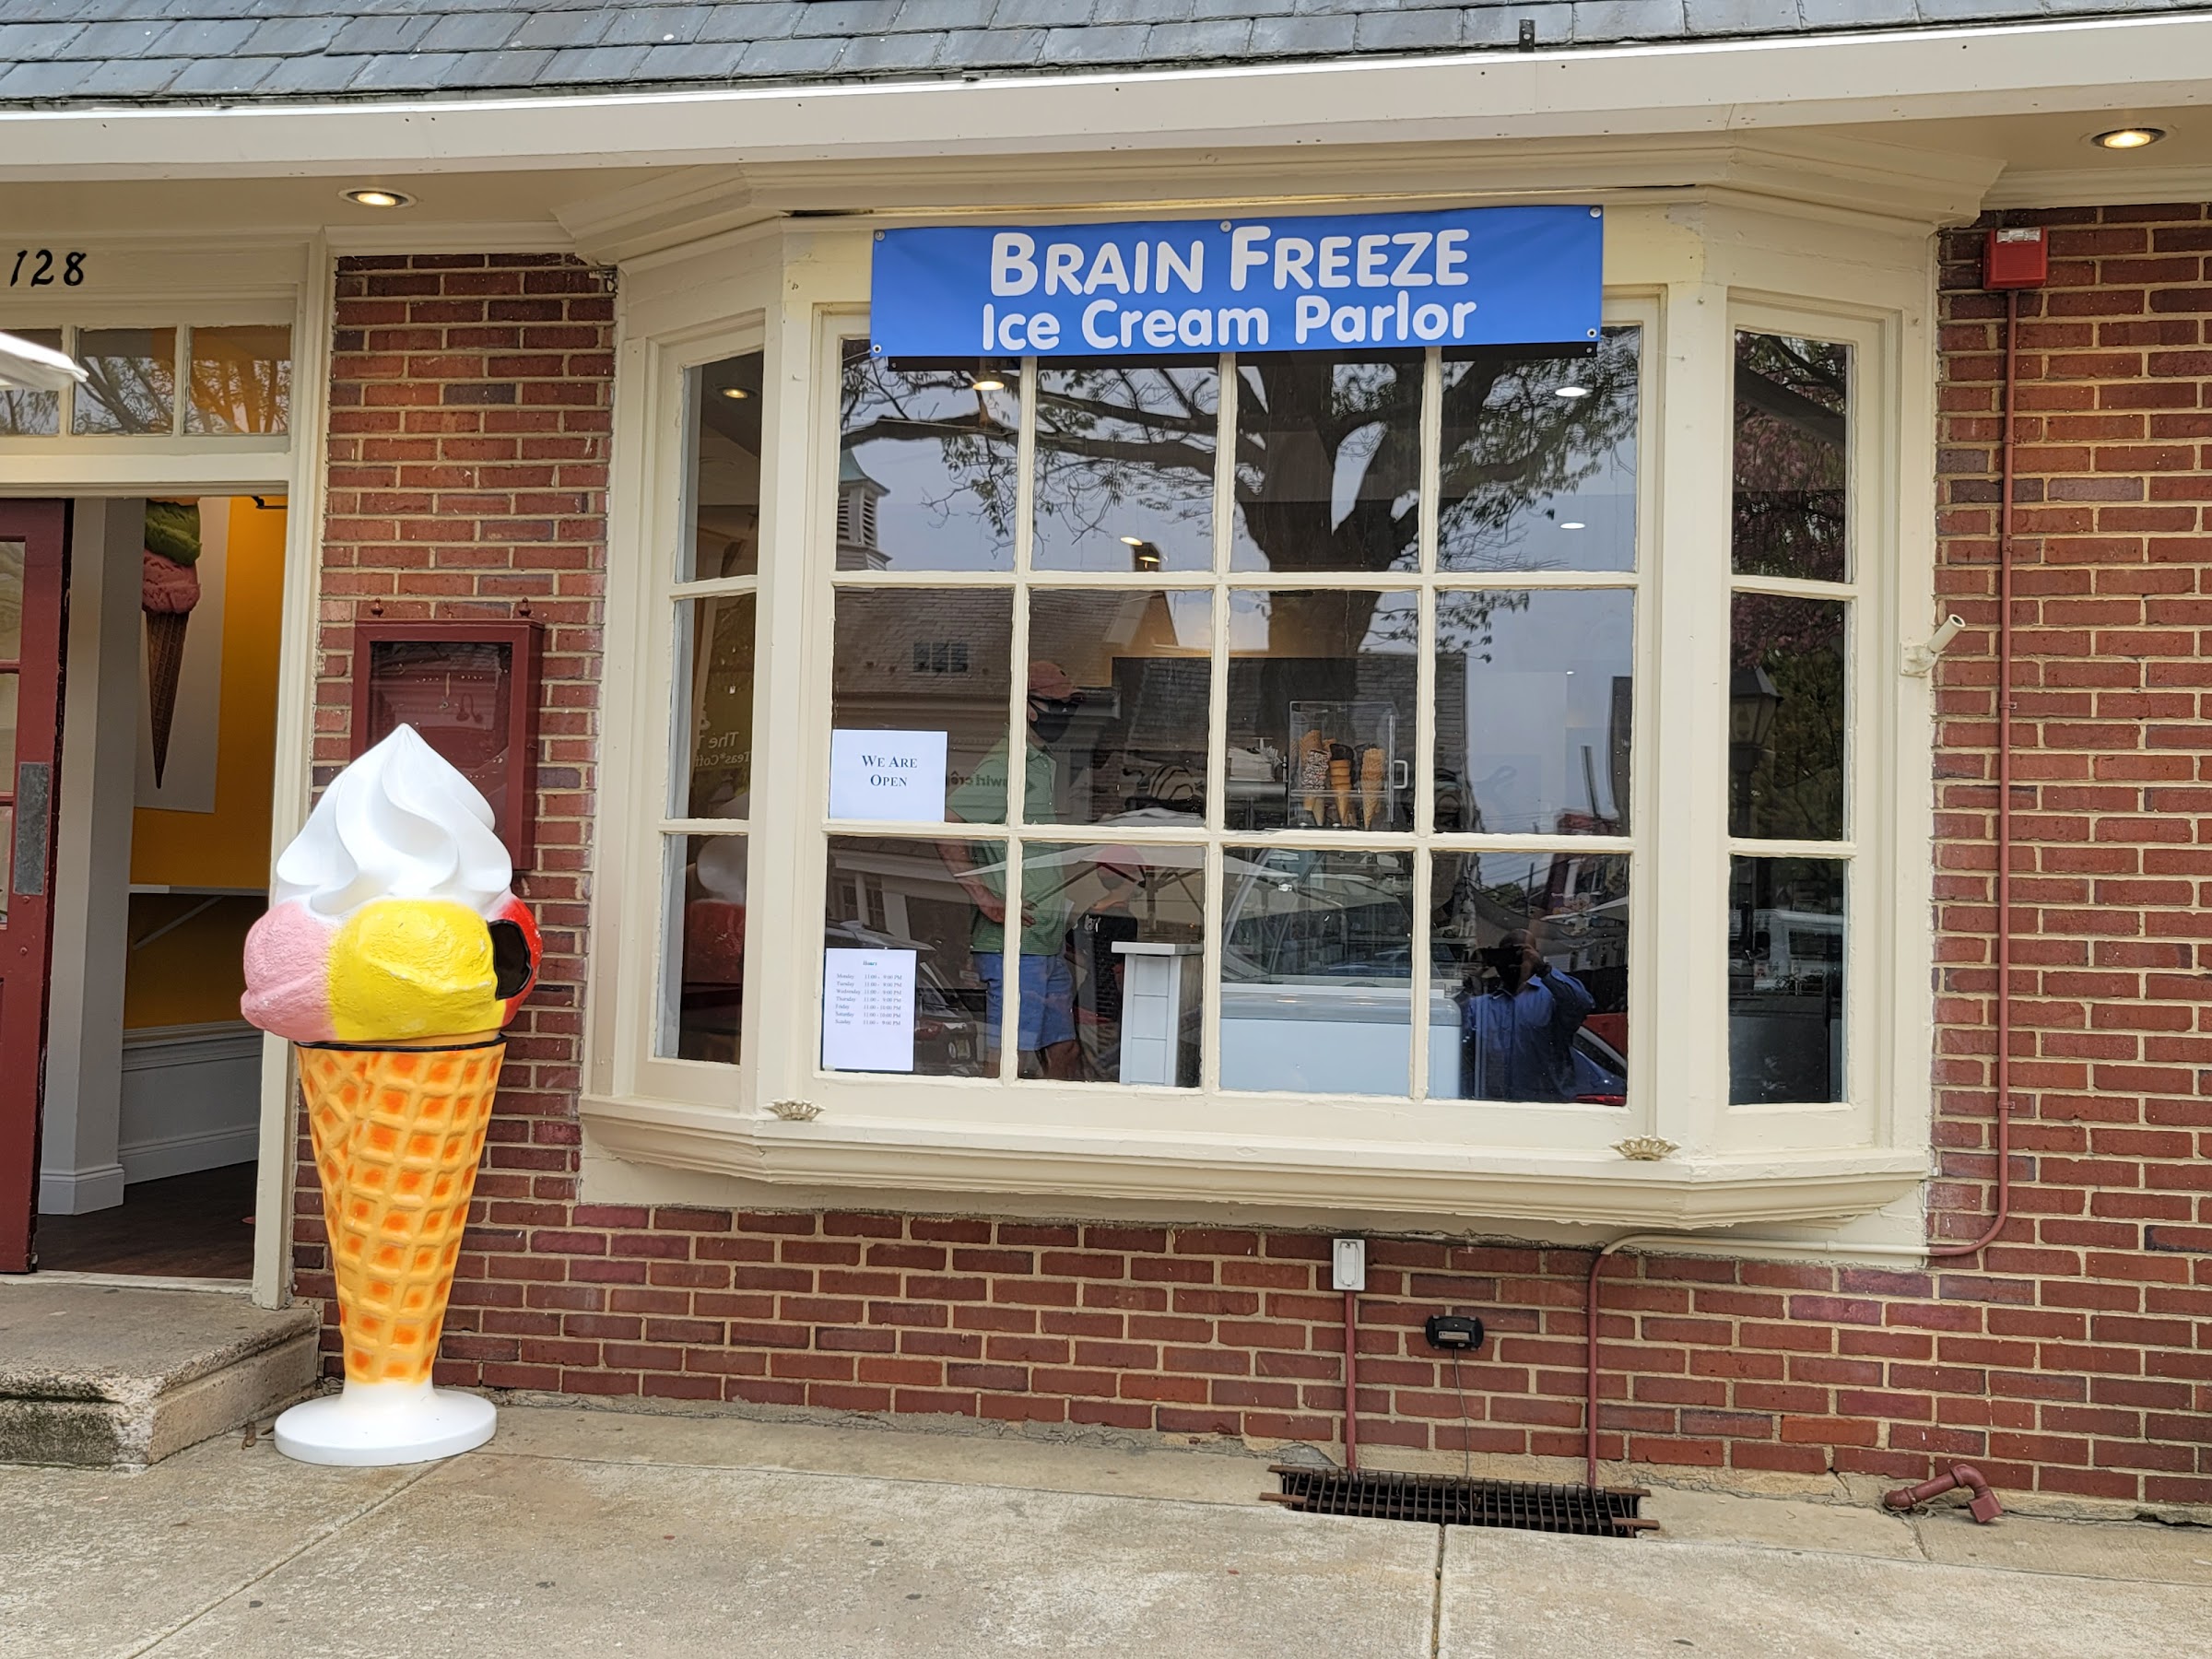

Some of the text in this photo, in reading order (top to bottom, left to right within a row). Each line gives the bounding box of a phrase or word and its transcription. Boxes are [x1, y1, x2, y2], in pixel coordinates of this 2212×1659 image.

[10, 249, 87, 287] 128
[991, 226, 1470, 297] BRAIN FREEZE
[982, 289, 1477, 350] Ice Cream Parlor
[862, 755, 918, 769] WE ARE
[870, 773, 908, 787] OPEN
